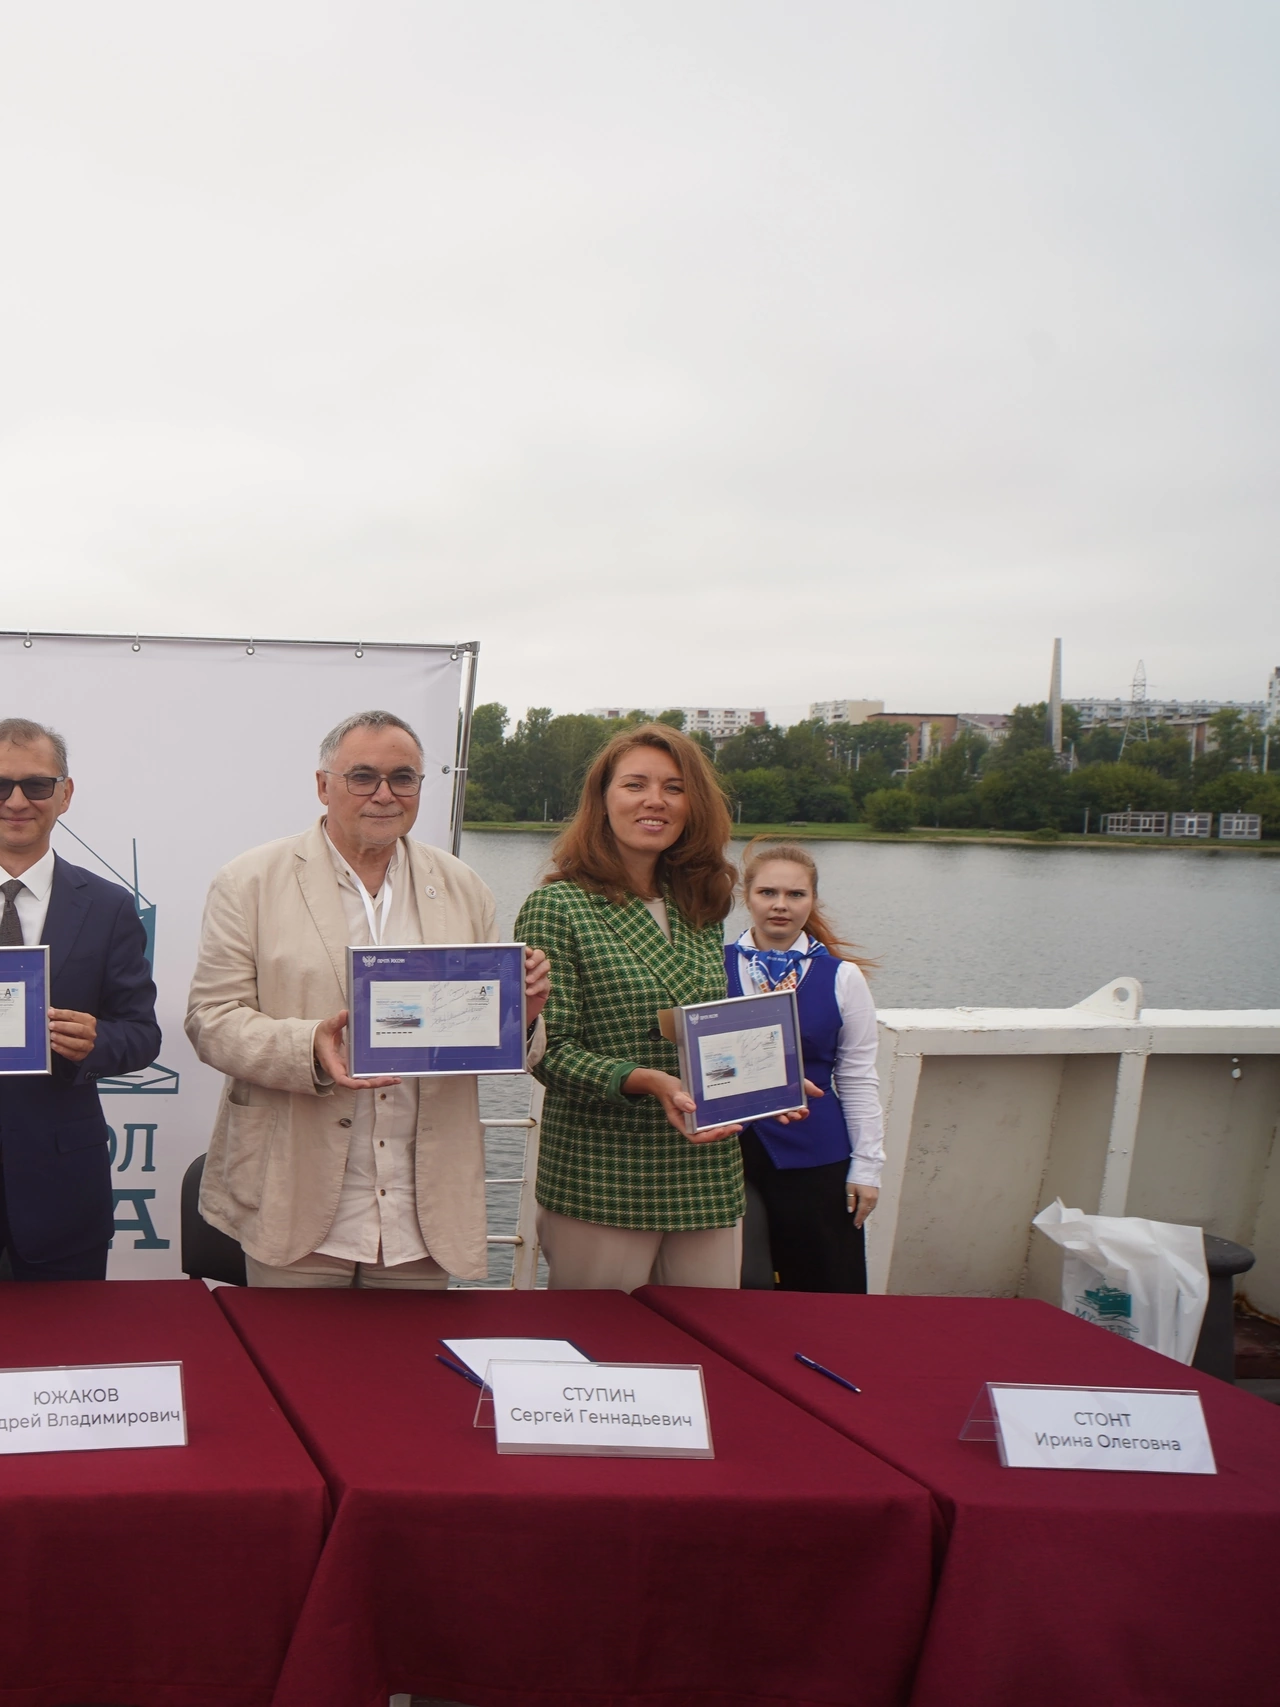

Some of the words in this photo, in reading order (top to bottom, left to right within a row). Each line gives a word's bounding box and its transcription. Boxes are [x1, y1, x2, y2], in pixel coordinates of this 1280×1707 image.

[33, 1388, 120, 1406] ЮЖАКОВ
[562, 1386, 636, 1403] СТУПИН
[47, 1410, 180, 1428] Владимирович
[510, 1407, 574, 1425] Сергей
[579, 1409, 692, 1427] Геннадьевич
[1073, 1412, 1132, 1427] СТОНТ
[1034, 1432, 1093, 1448] Ирина
[1096, 1433, 1182, 1451] Олеговна
